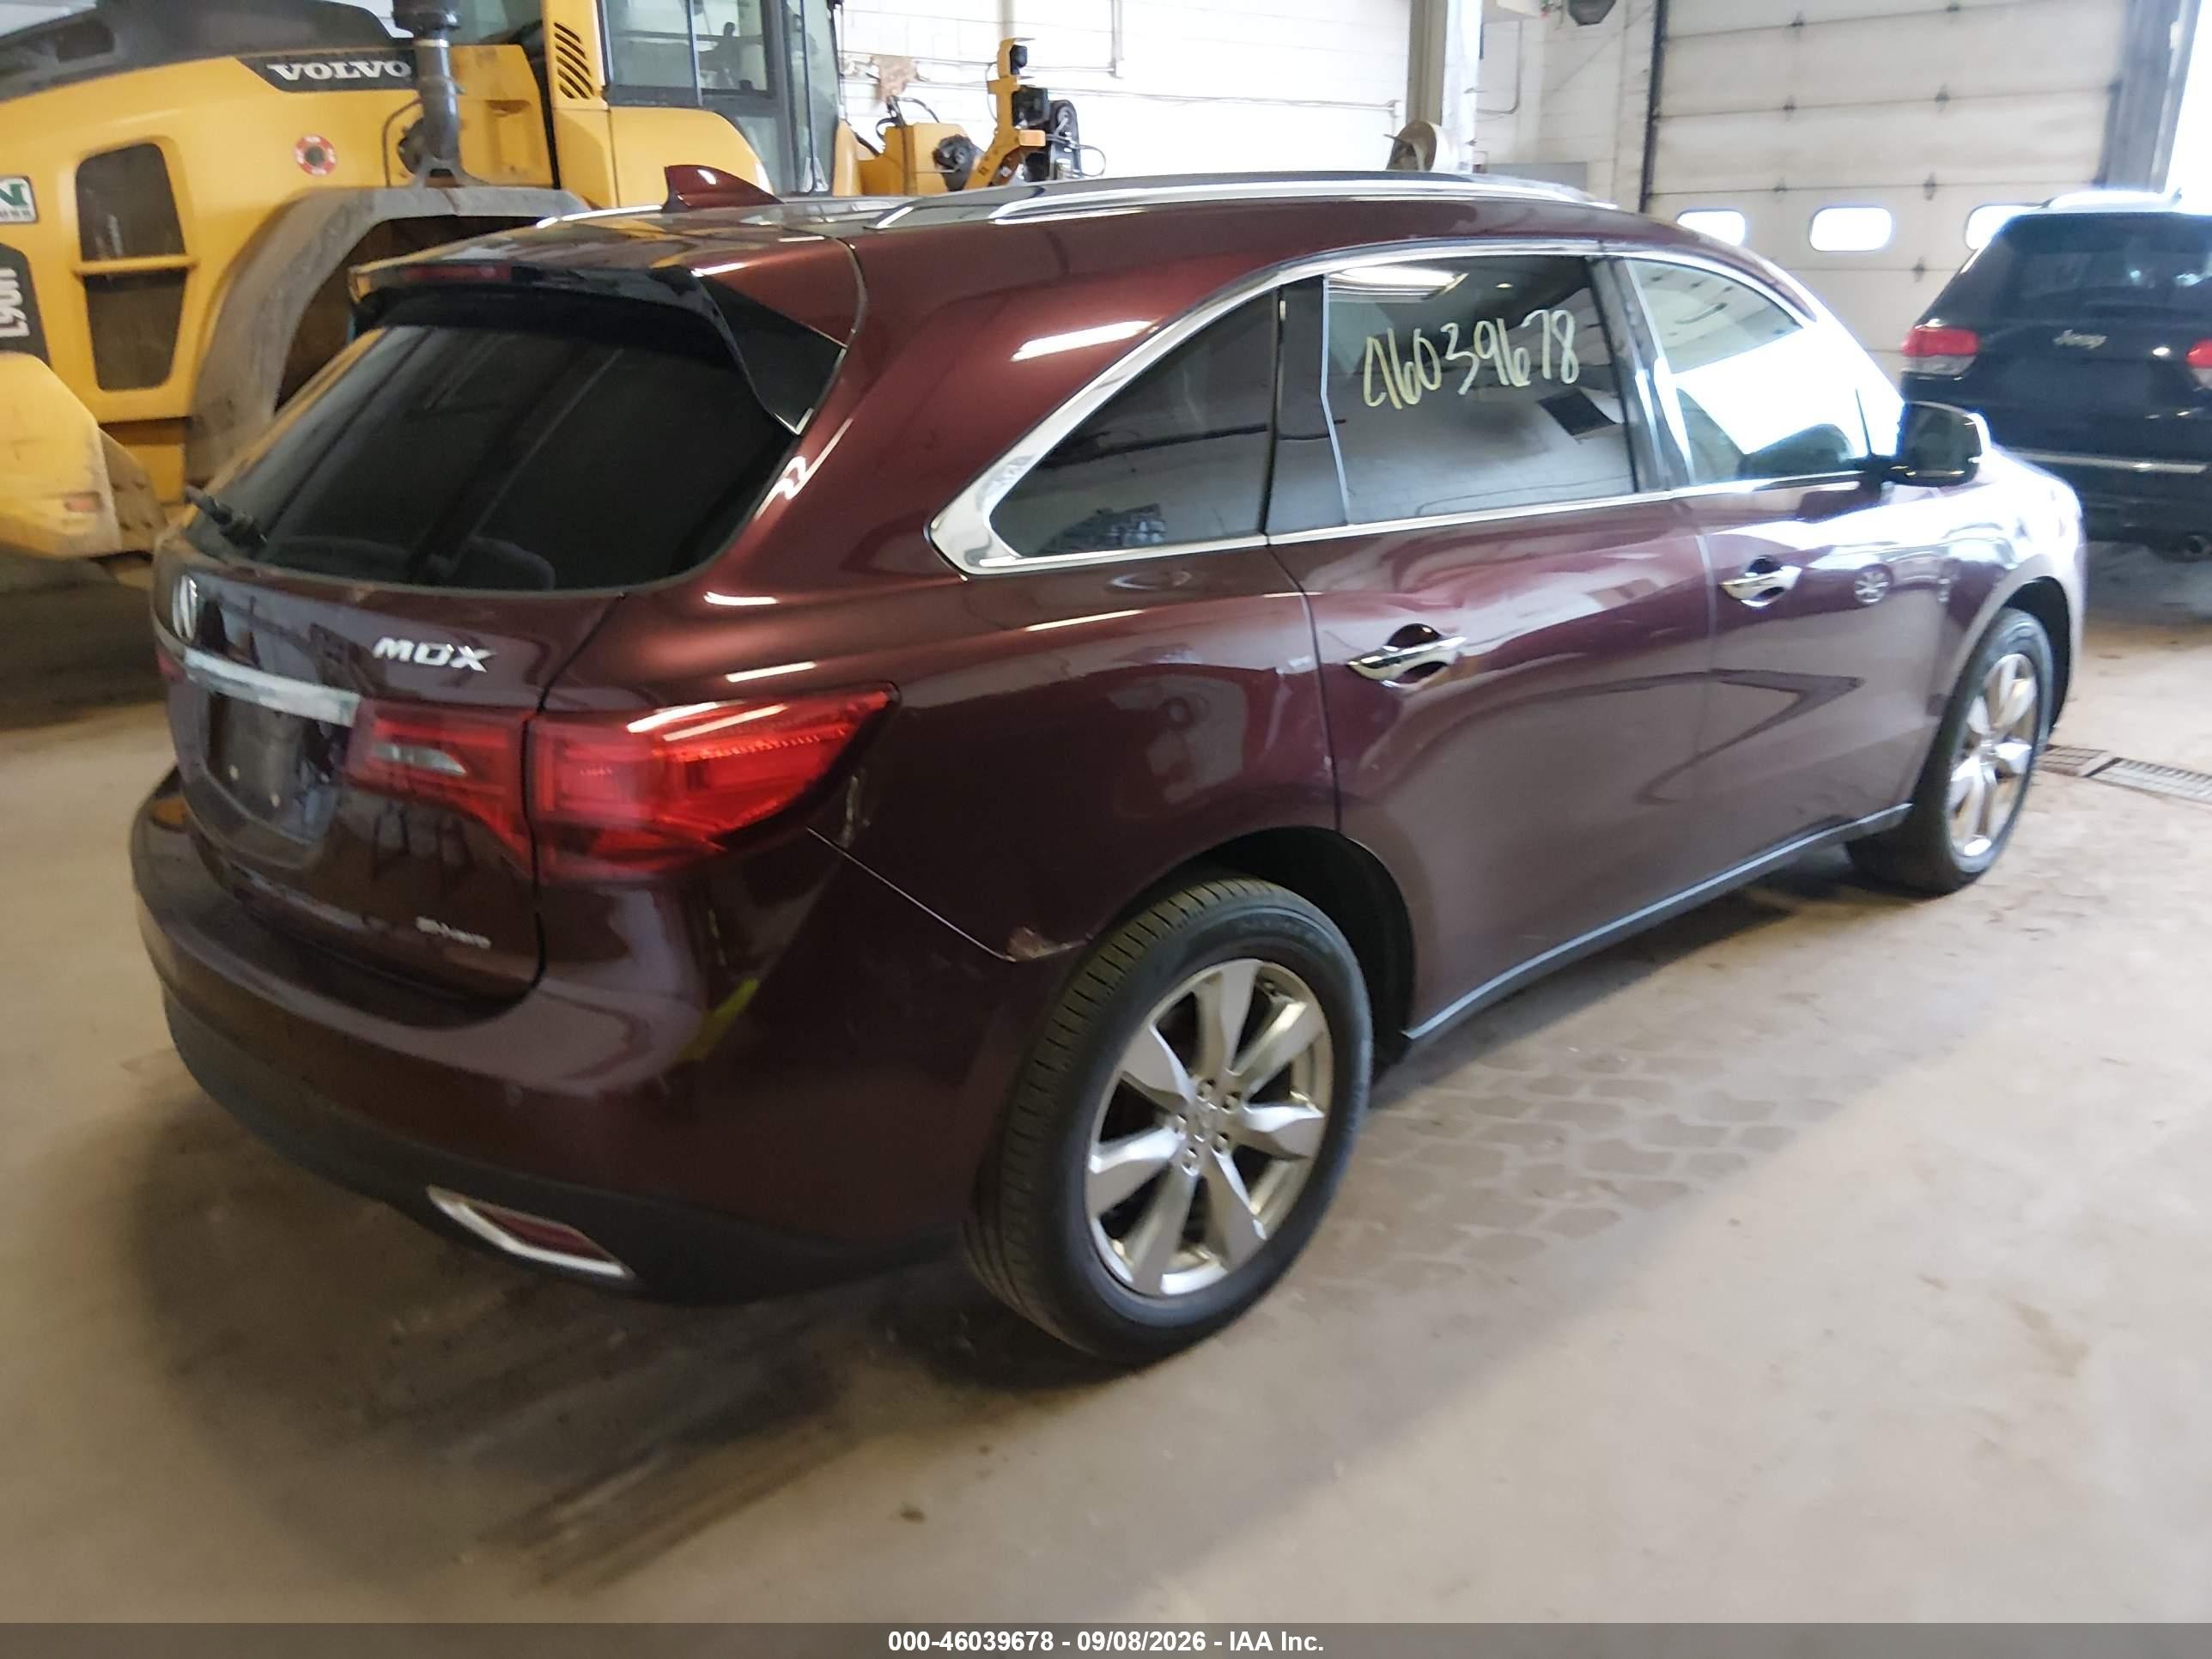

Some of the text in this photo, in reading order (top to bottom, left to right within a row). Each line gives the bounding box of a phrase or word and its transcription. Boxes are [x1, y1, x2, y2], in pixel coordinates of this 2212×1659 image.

[266, 60, 412, 81] VOLVO
[1362, 308, 1581, 410] 46039678
[373, 636, 496, 673] MDX
